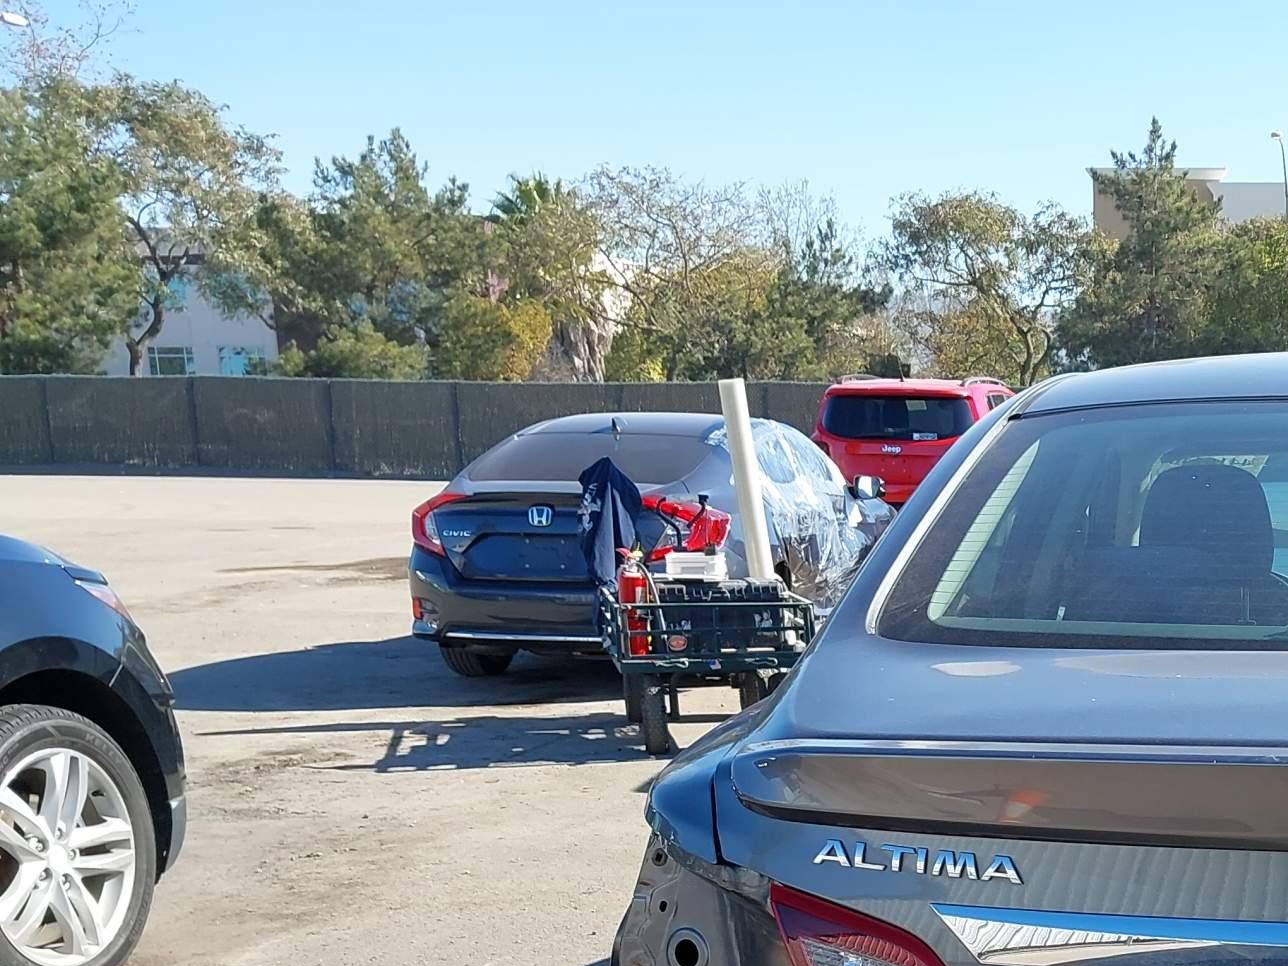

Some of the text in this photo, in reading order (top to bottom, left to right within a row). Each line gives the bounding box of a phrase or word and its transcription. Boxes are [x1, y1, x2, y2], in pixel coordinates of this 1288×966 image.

[881, 443, 902, 454] Jeep
[442, 530, 472, 538] CIVIC
[812, 838, 1025, 885] ALTIMA
